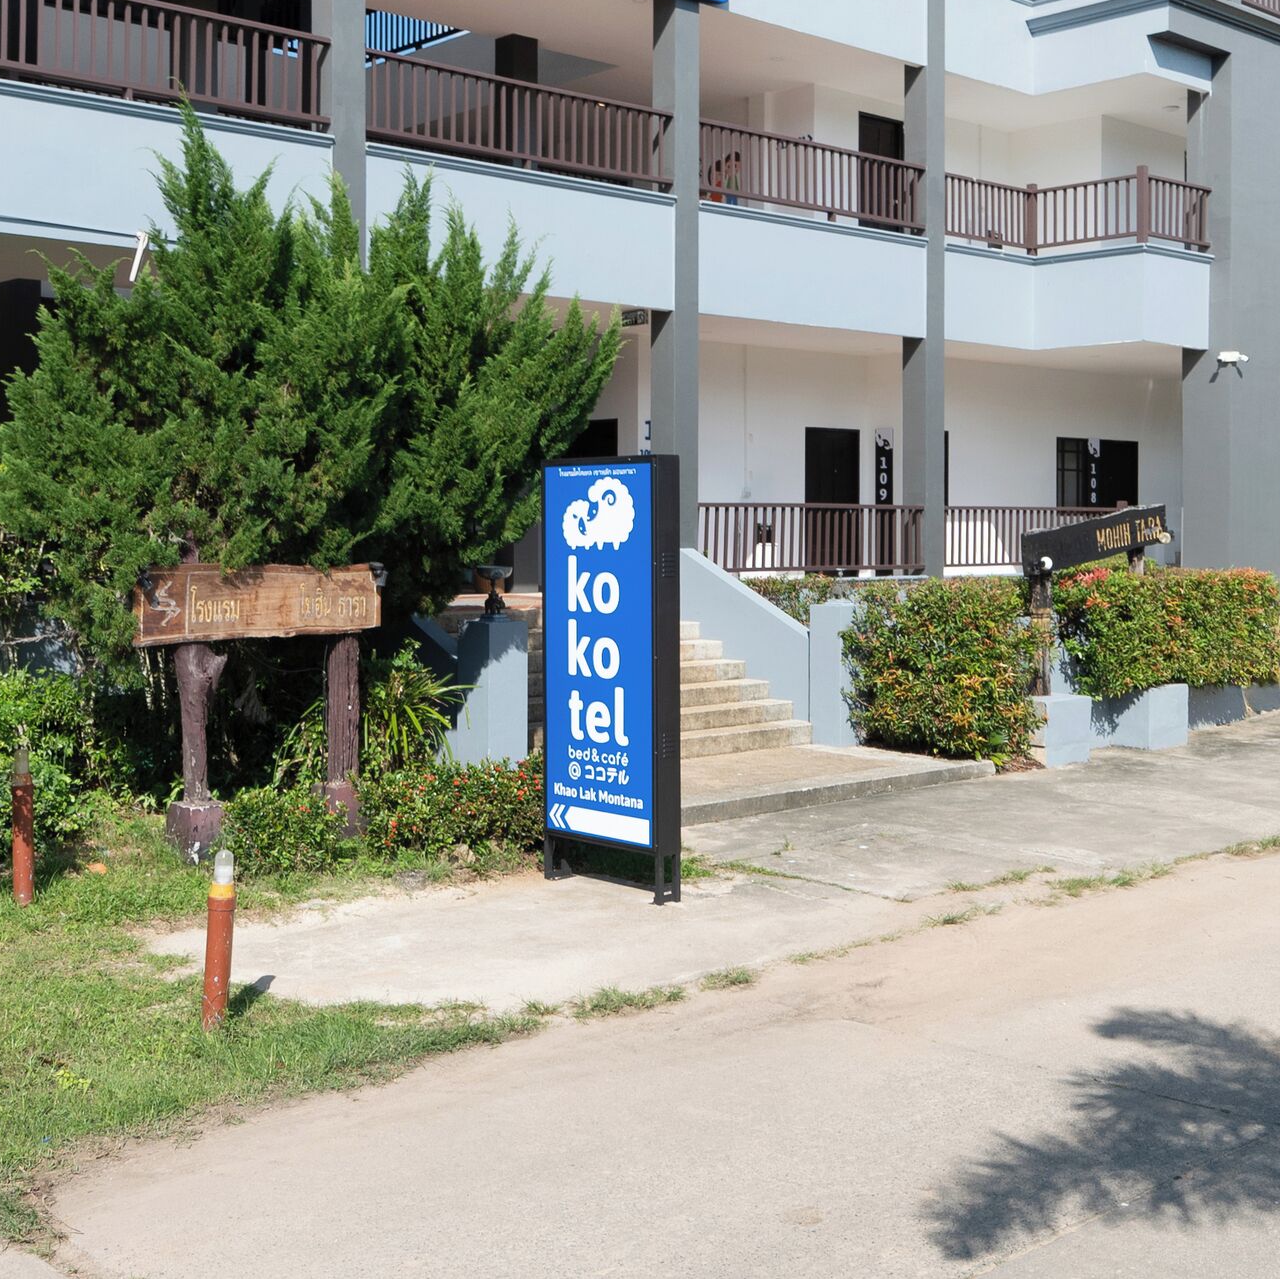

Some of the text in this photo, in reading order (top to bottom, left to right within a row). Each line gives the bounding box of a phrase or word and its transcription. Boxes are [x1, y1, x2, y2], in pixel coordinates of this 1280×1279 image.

[880, 457, 888, 500] 109
[1096, 521, 1131, 552] MOHIN
[190, 584, 240, 623] โรงแรม
[338, 594, 367, 617] ธารา
[567, 554, 620, 614] ko
[567, 618, 620, 679] ko
[568, 686, 630, 747] tel
[568, 761, 630, 785] @ ココテル
[553, 782, 644, 810] Khao Lak Montana
